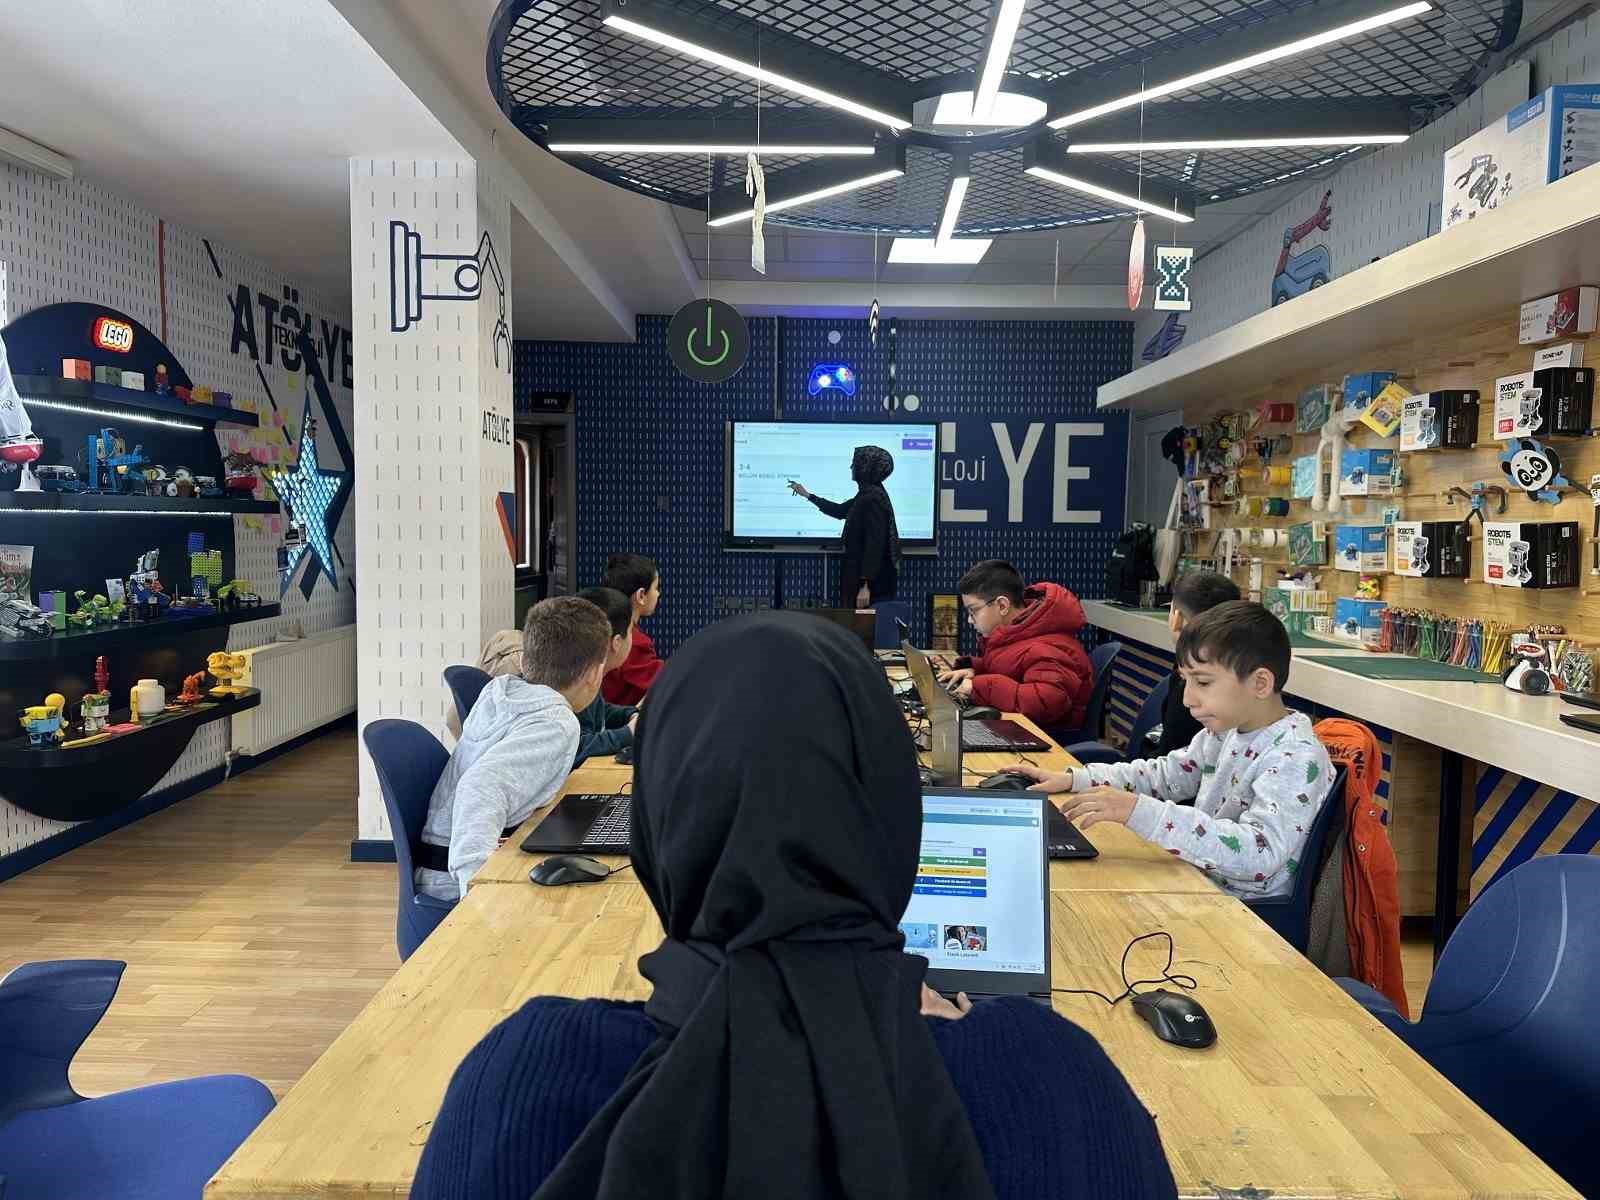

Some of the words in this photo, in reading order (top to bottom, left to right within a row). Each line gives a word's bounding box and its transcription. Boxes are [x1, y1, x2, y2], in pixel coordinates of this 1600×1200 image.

[102, 322, 129, 348] LEGO
[1500, 381, 1524, 392] ROBOTIS
[1500, 391, 1516, 400] STEM
[482, 406, 511, 445] ATÖLYE
[1487, 530, 1511, 538] ROBOTIS
